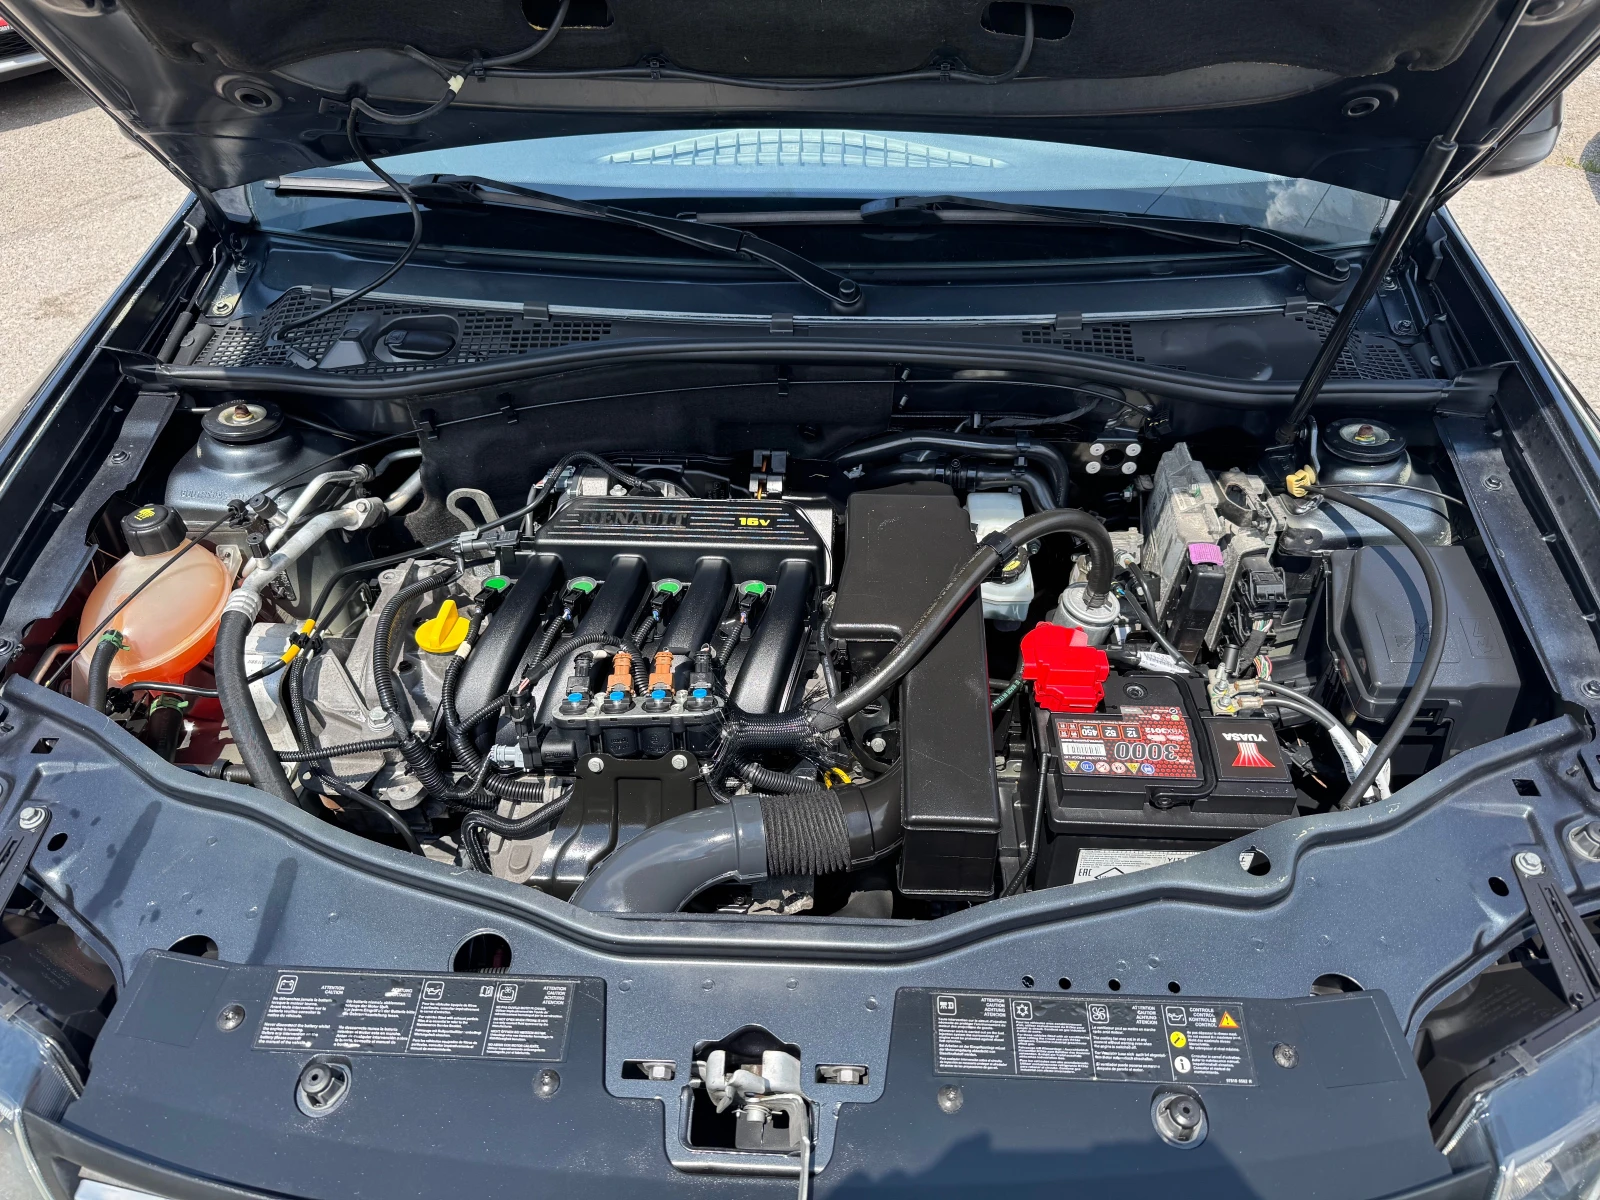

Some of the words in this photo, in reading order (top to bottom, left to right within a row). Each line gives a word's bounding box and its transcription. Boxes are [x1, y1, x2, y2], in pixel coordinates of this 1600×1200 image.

[580, 512, 687, 526] RENAULT
[738, 516, 771, 526] 16v
[1222, 732, 1268, 742] YUASA
[1115, 742, 1180, 761] 3000
